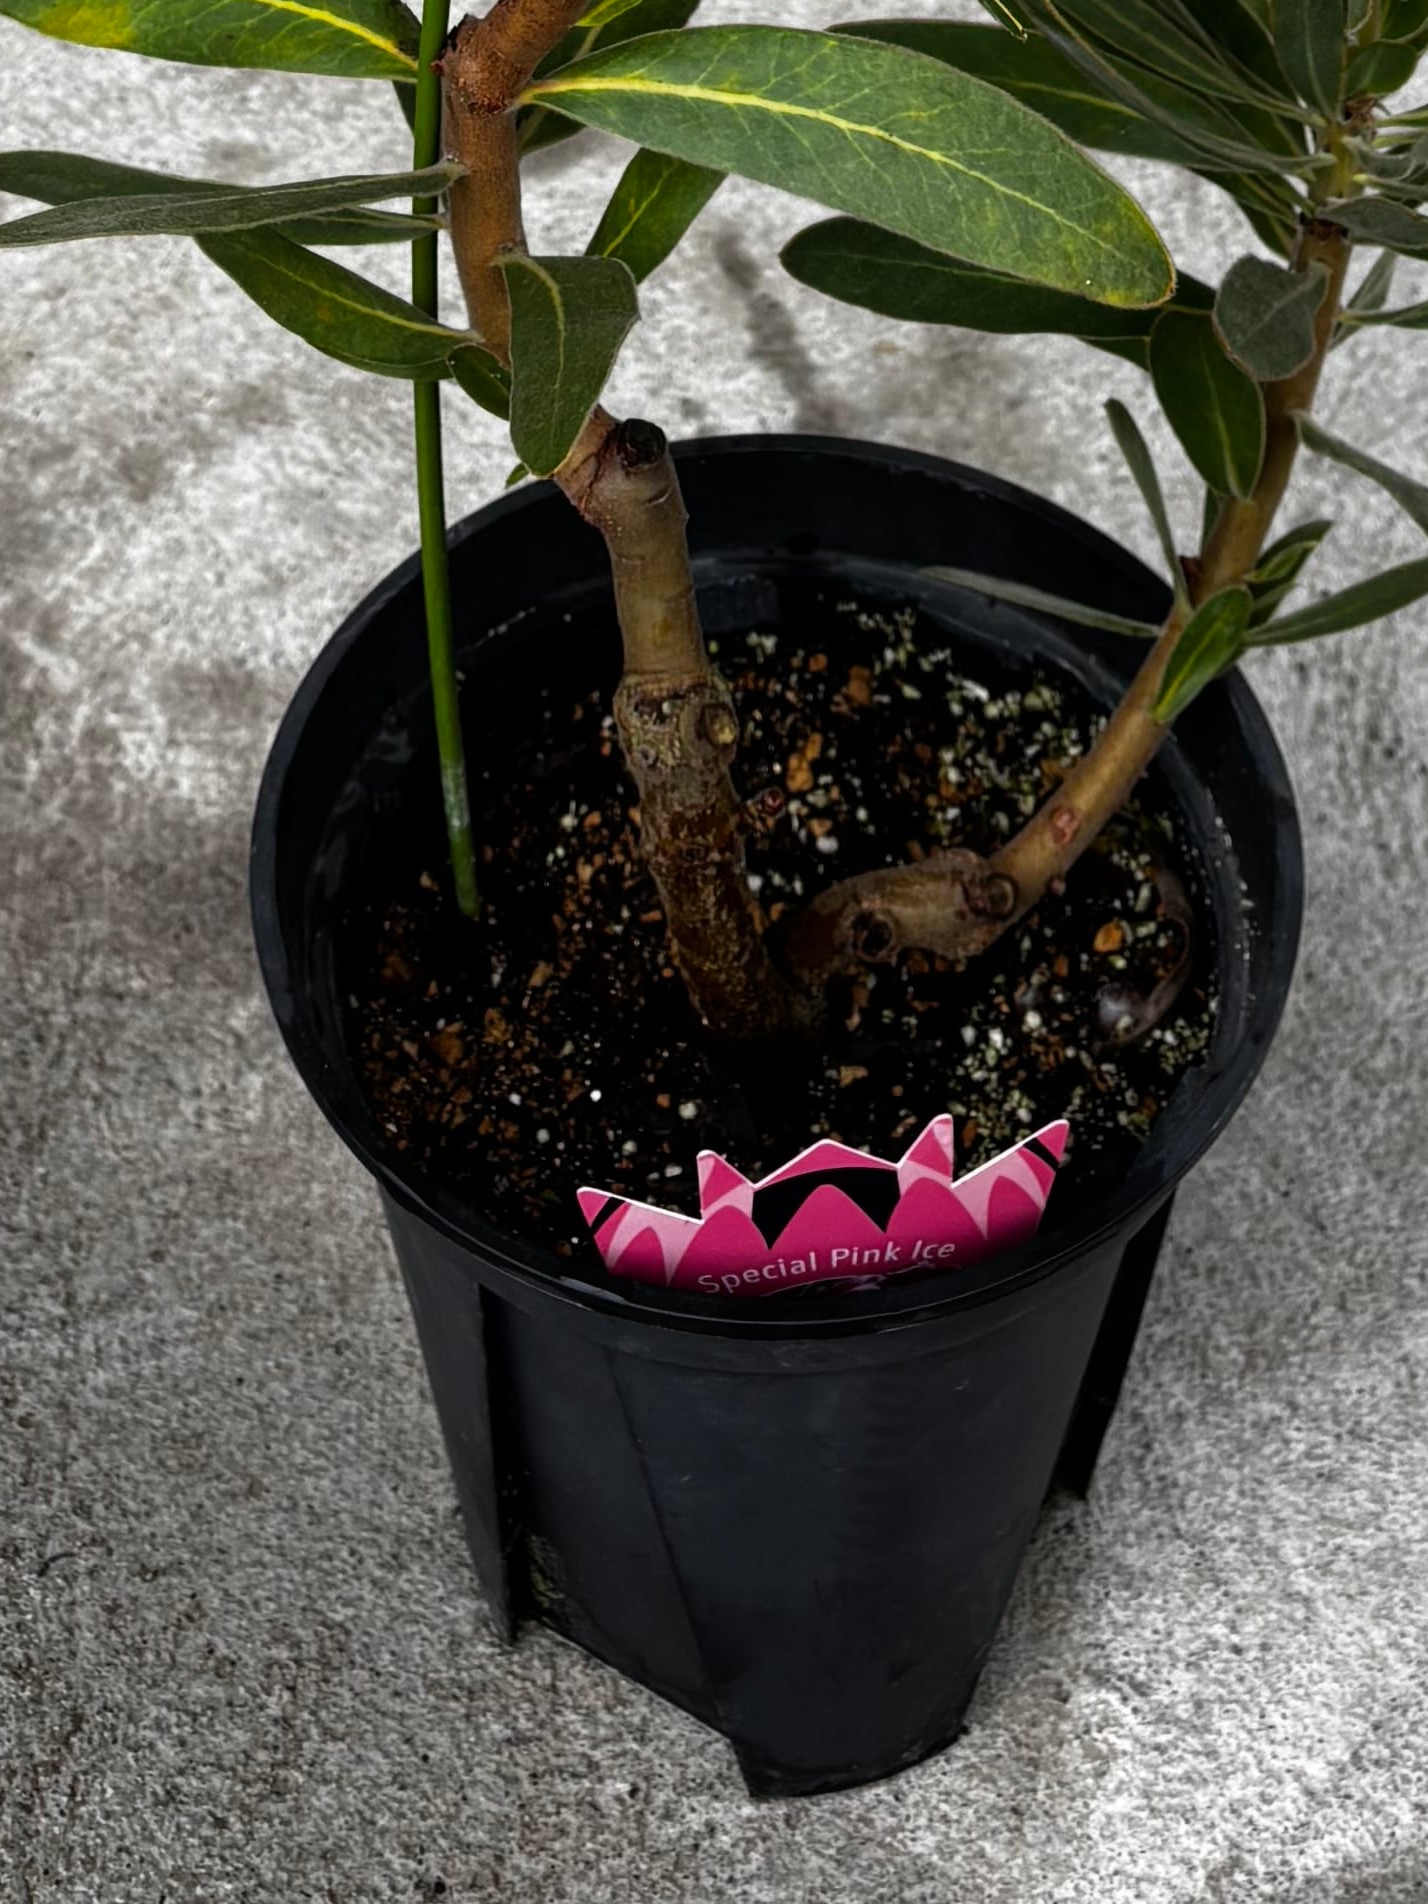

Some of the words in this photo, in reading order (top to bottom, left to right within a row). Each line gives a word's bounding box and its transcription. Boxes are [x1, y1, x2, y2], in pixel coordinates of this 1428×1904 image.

[697, 1251, 818, 1294] Special
[832, 1242, 901, 1268] Pink
[912, 1239, 956, 1261] Ice
